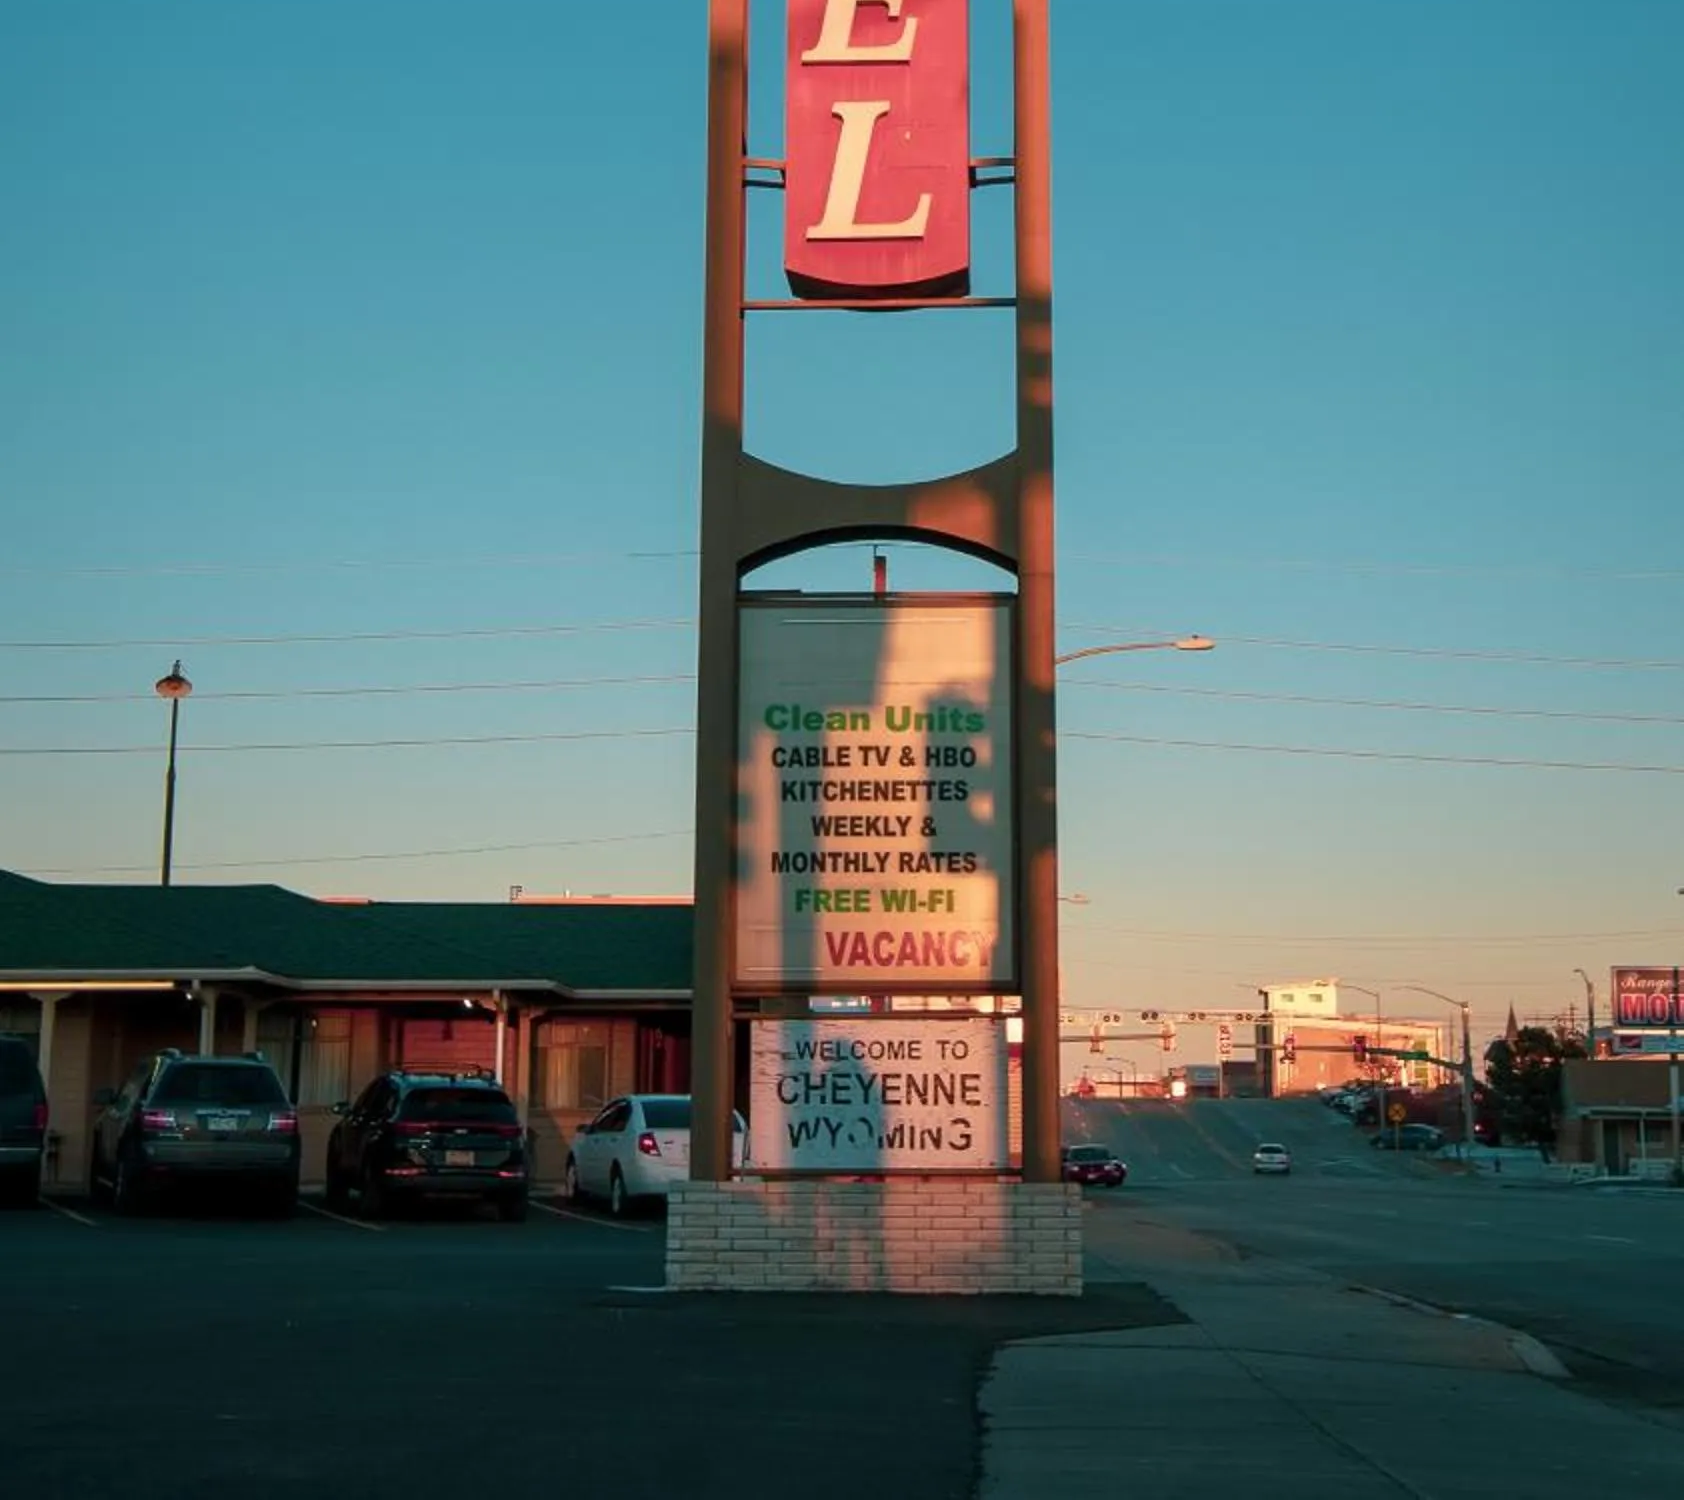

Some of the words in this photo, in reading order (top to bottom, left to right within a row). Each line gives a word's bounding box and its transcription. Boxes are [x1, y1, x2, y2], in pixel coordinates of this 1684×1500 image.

[764, 704, 870, 732] Clean
[885, 705, 985, 733] Units
[771, 745, 850, 768] CABLE
[858, 745, 891, 768] TV
[899, 745, 916, 768] &
[925, 745, 976, 768] HBO
[781, 780, 968, 801] KITCHENETTES
[811, 816, 912, 837] WEEKLY
[920, 816, 937, 837] &
[771, 852, 890, 874] MONTHLY
[899, 852, 976, 874] RATES
[795, 889, 871, 912] FREE
[881, 889, 955, 912] WI-FI
[825, 931, 997, 968] VACANCY
[796, 1040, 921, 1060] WELCOME
[937, 1040, 969, 1060] TO
[777, 1073, 981, 1106] CHEYENNE
